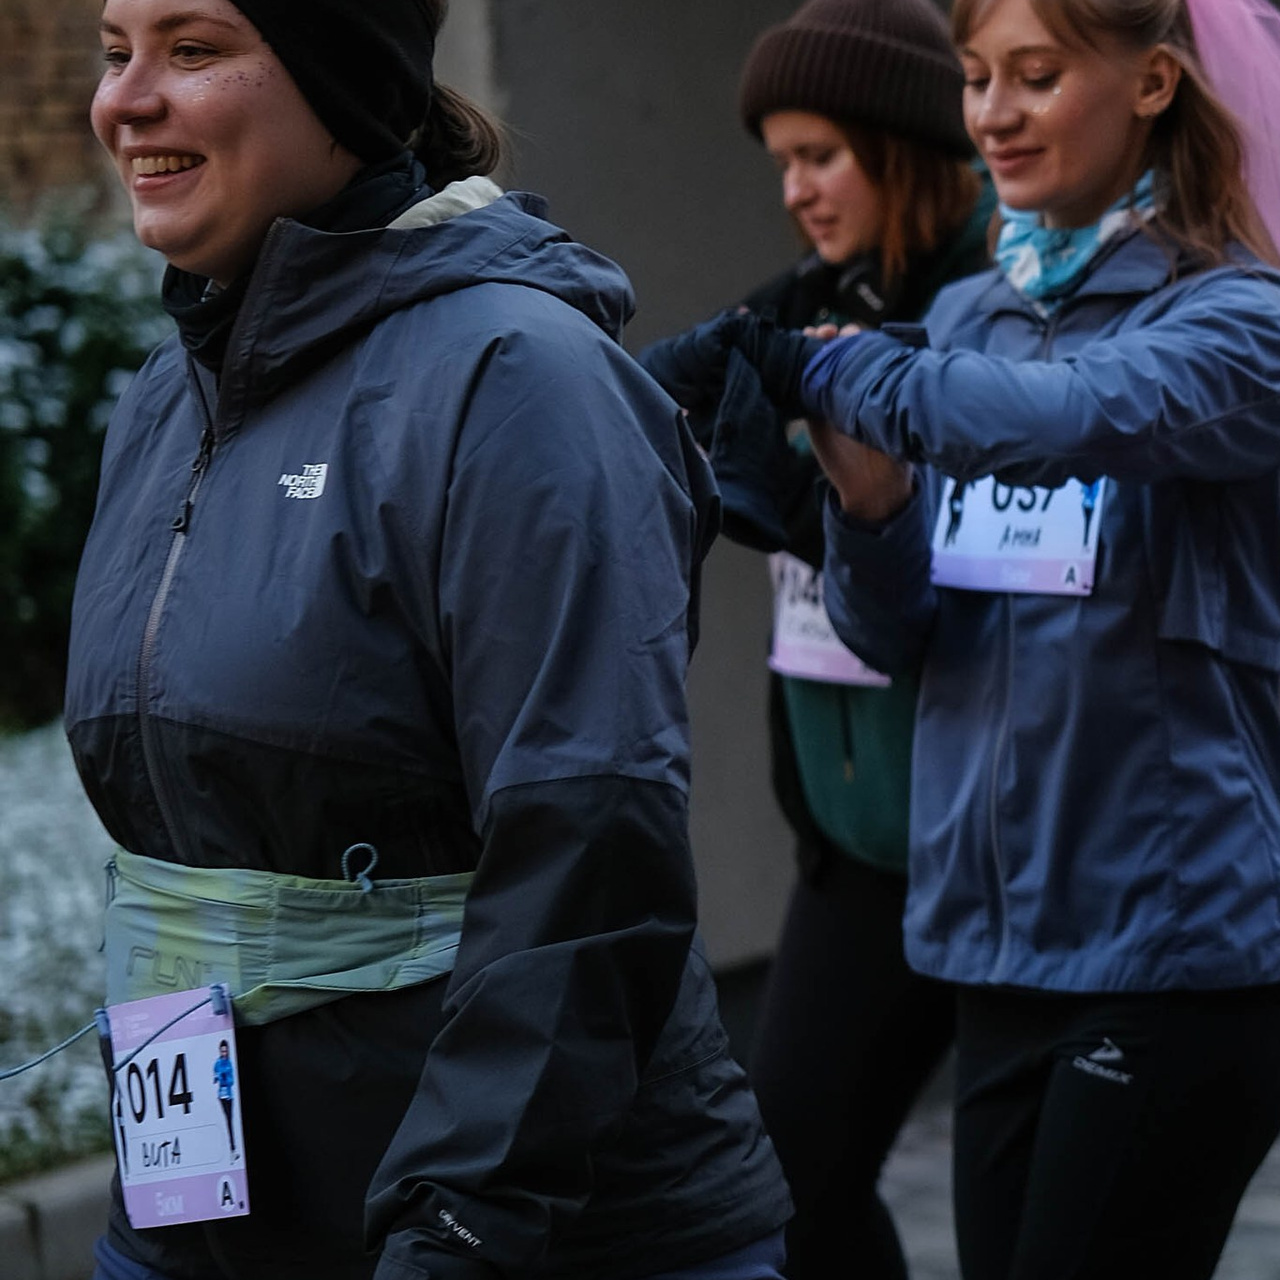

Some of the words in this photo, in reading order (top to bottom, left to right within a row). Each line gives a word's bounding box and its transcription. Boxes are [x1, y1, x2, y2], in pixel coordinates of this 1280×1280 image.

[302, 464, 323, 476] THE
[277, 473, 318, 487] NORTH
[285, 486, 318, 499] FACE
[127, 1053, 194, 1124] 014
